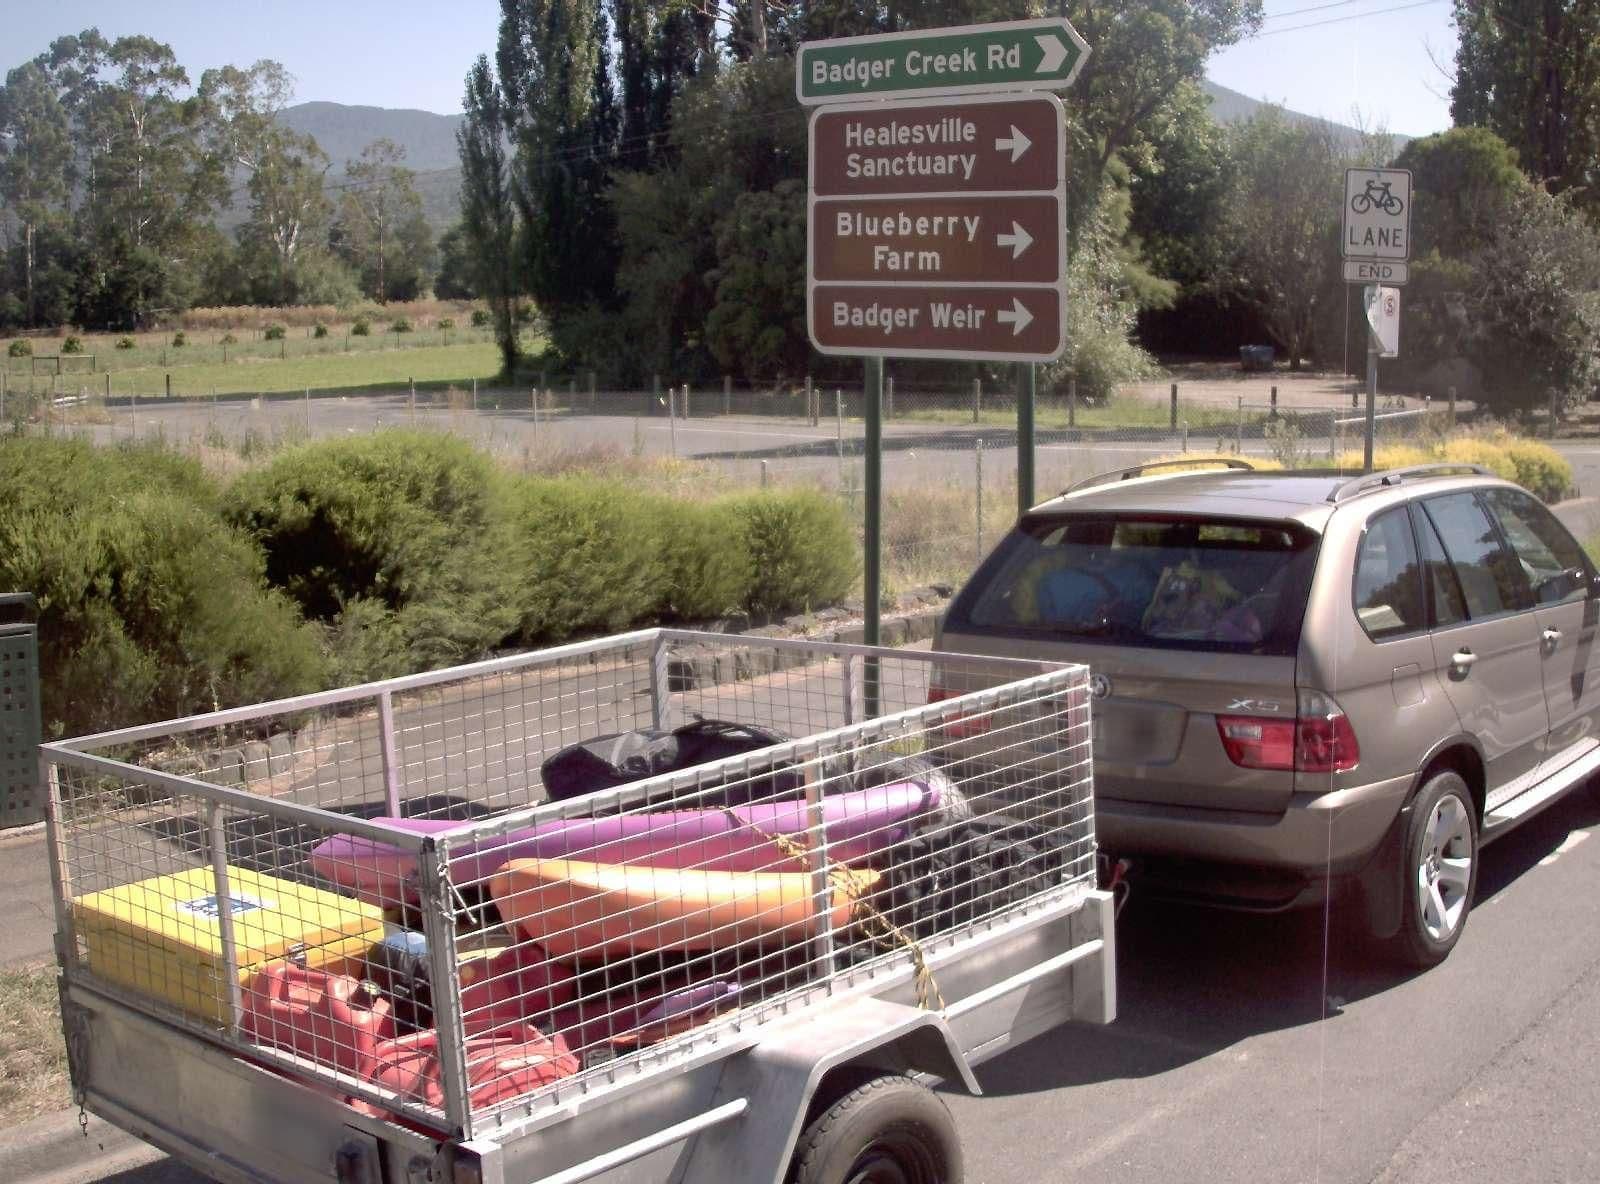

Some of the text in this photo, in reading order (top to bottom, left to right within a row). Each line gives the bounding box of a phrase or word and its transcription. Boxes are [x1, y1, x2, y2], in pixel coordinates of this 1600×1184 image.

[812, 44, 1020, 86] Badger Creek Rd
[845, 118, 976, 147] Healesville
[846, 151, 976, 179] Sanctuary
[836, 212, 980, 241] Blueberry
[1350, 226, 1403, 247] LANE
[873, 246, 941, 271] Farm
[1358, 265, 1392, 278] END
[833, 303, 986, 334] Badger Weir
